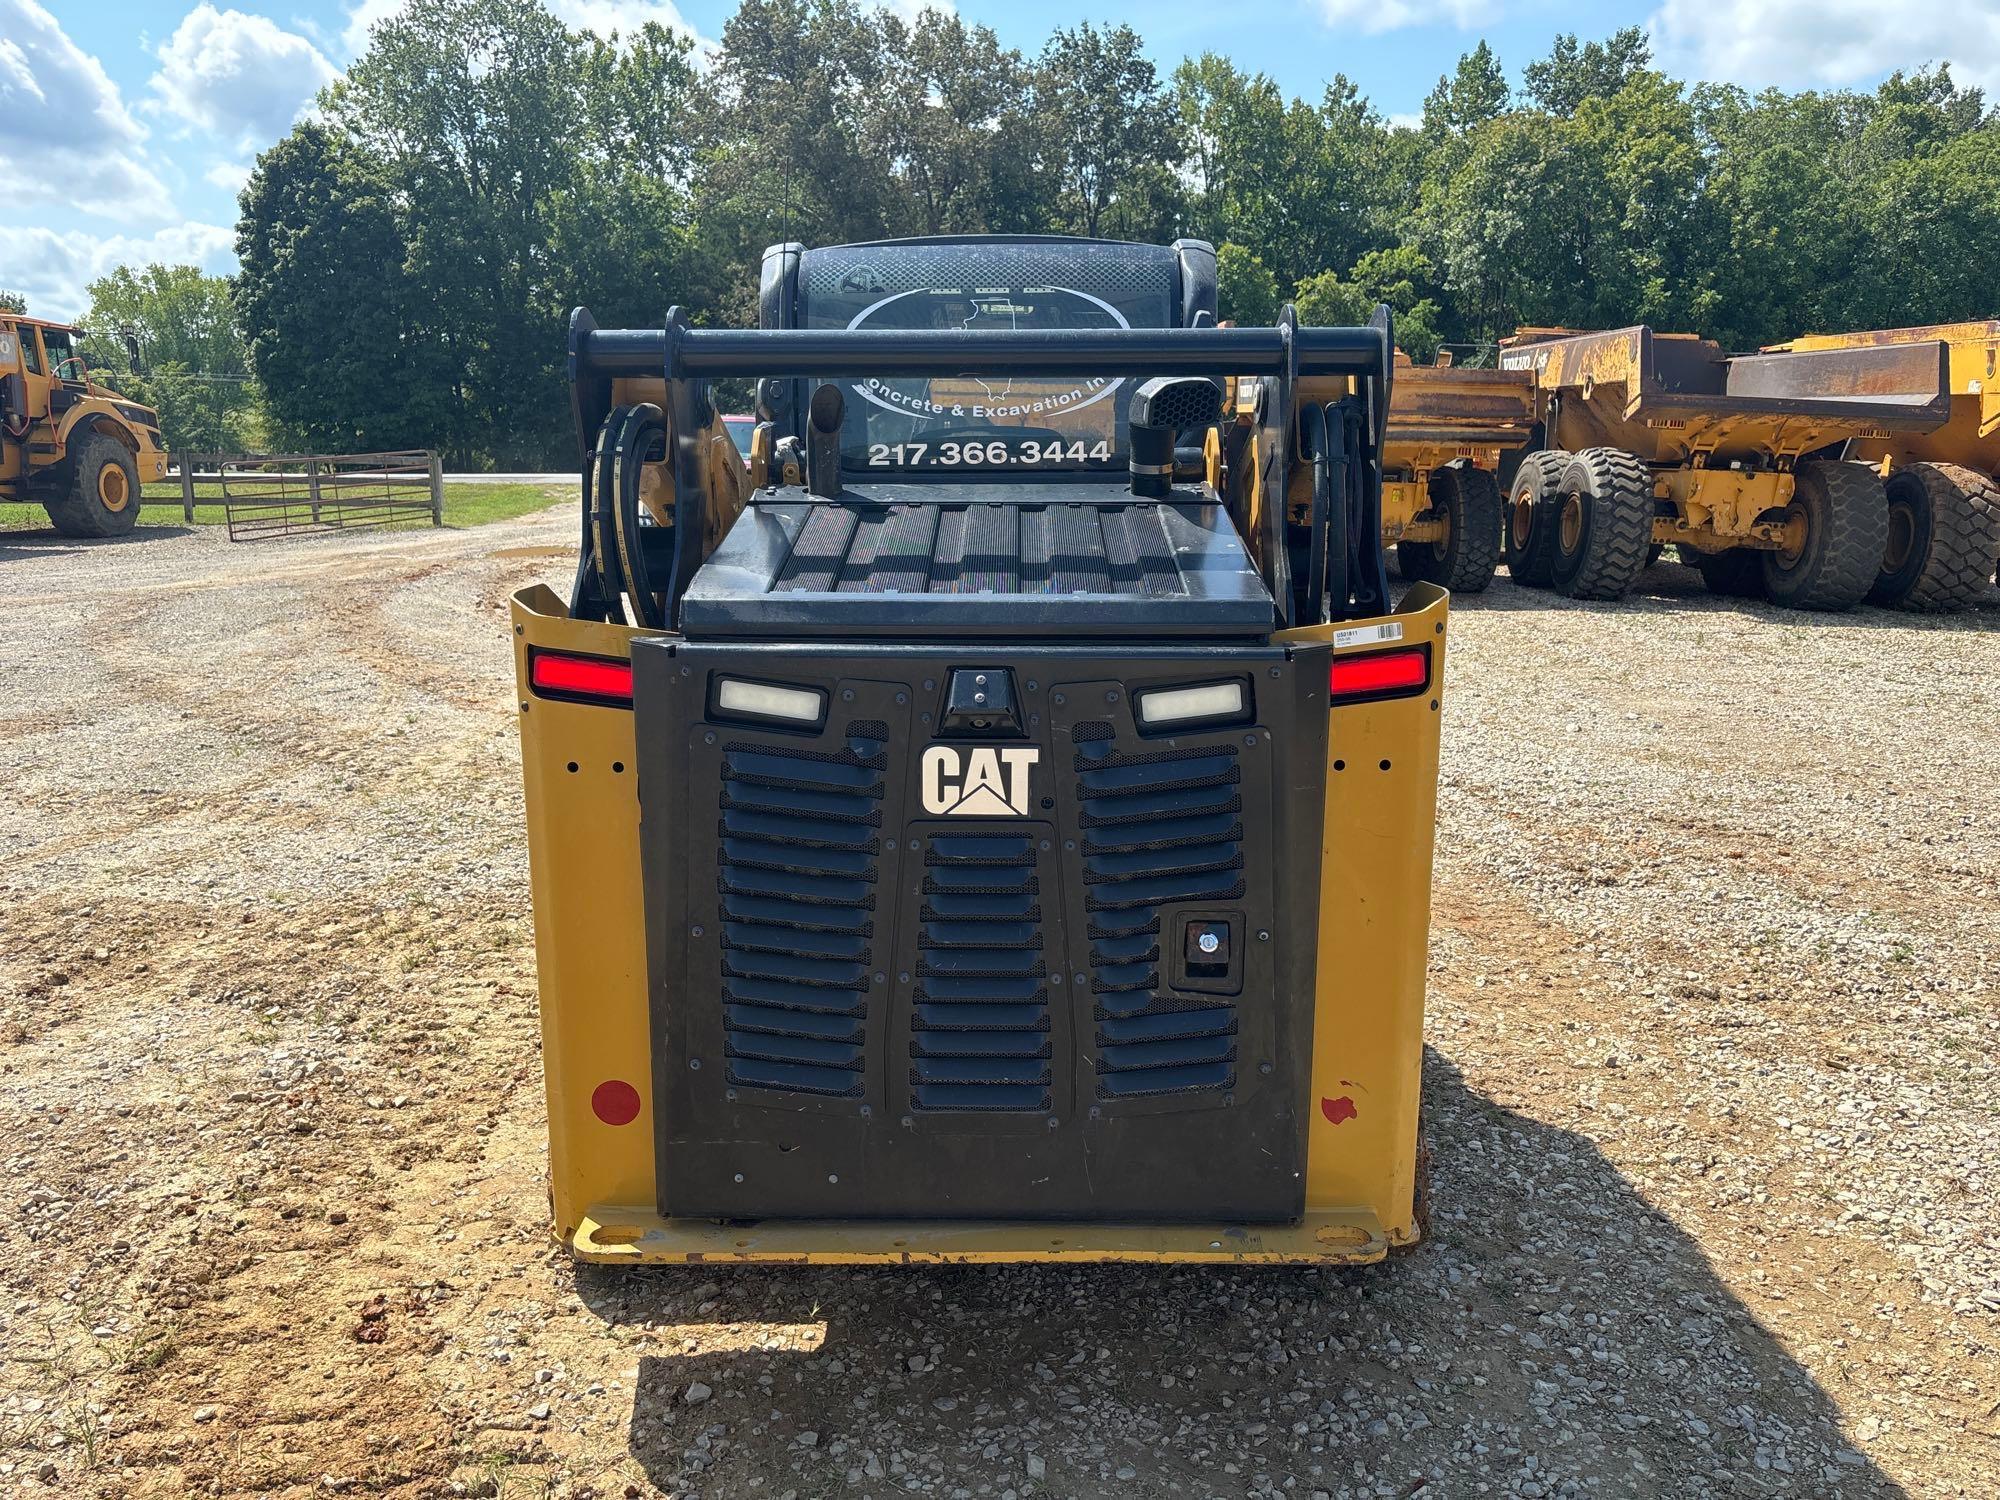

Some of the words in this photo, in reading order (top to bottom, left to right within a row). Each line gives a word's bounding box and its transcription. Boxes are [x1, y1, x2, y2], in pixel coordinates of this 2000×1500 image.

[1503, 355, 1530, 371] VOLVO
[869, 378, 943, 414] oncrete
[951, 404, 965, 417] &
[972, 389, 1082, 417] Excavation
[1086, 377, 1105, 391] In
[868, 441, 1111, 466] 217.366.3444
[922, 746, 1039, 815] CAT
